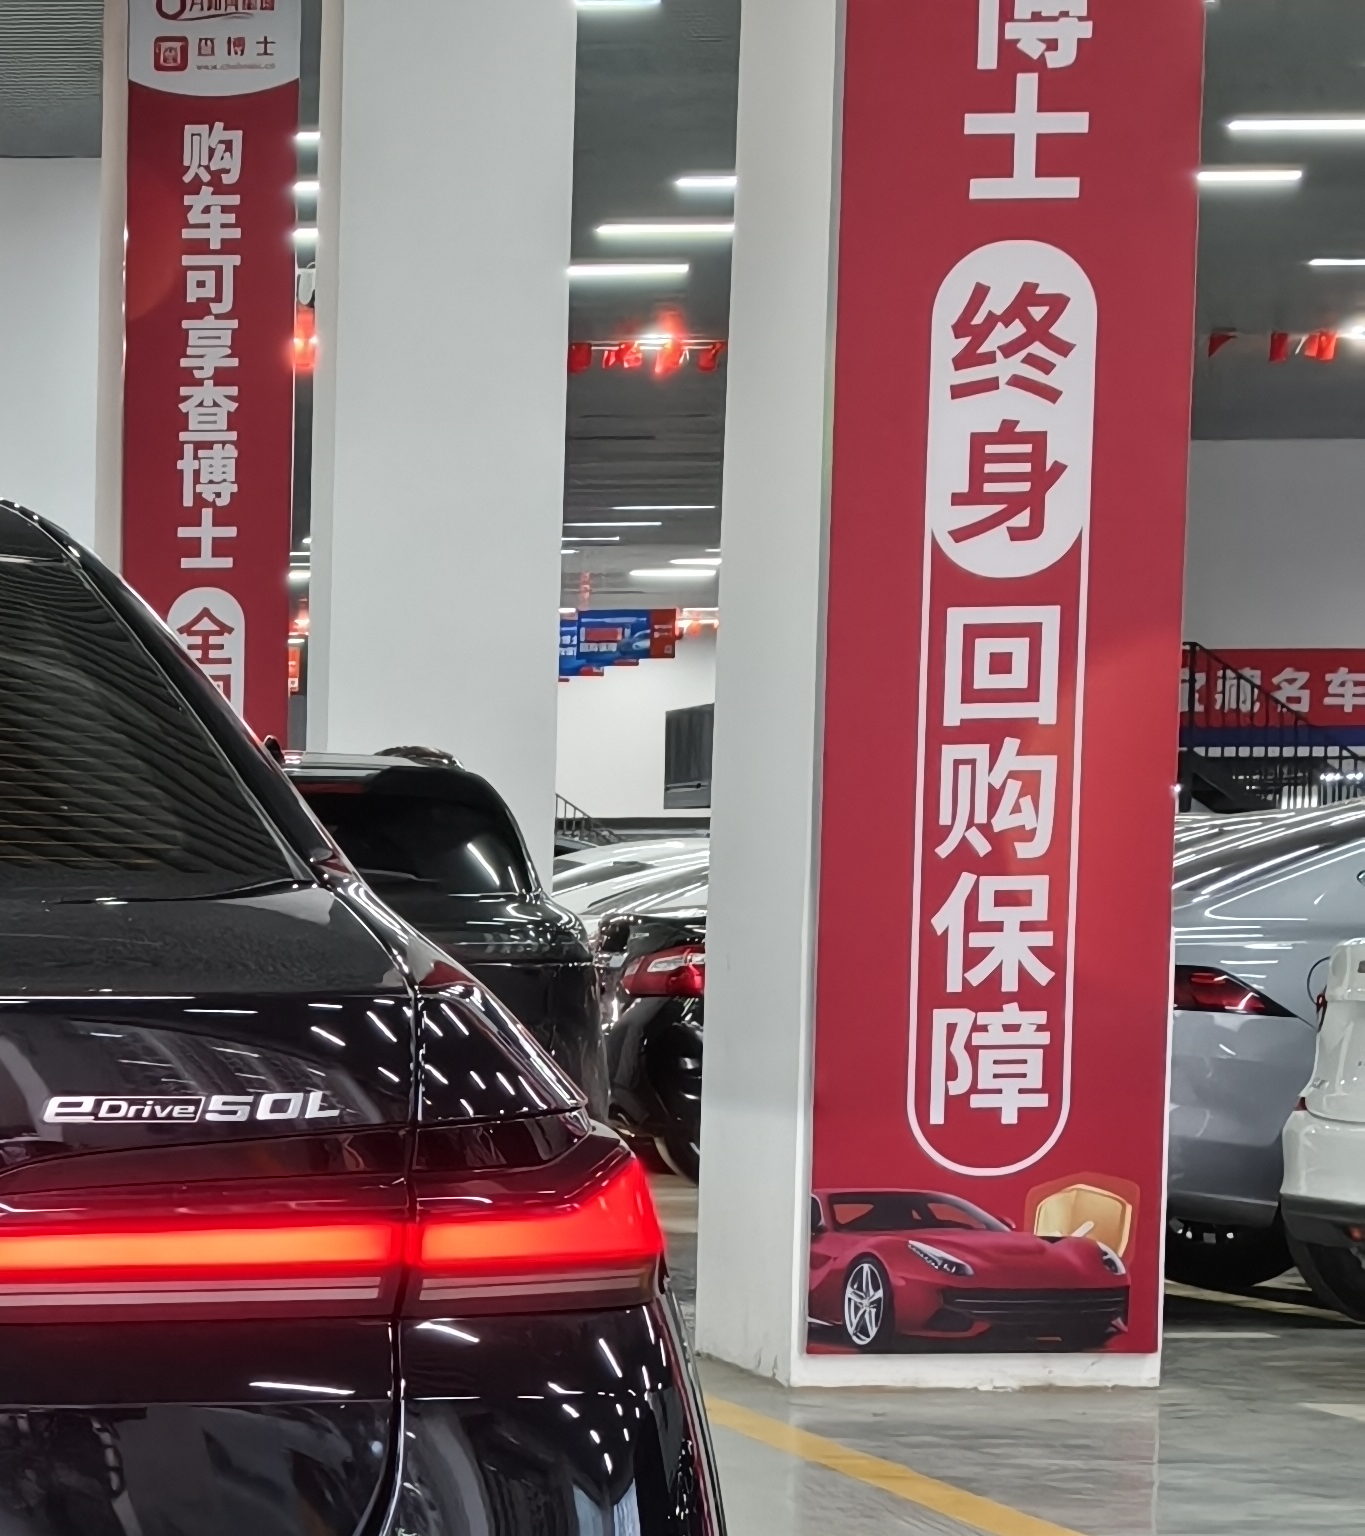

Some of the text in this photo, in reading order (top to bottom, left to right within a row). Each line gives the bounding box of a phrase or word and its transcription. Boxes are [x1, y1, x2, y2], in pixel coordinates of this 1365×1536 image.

[176, 121, 243, 569] 购车可享查博士
